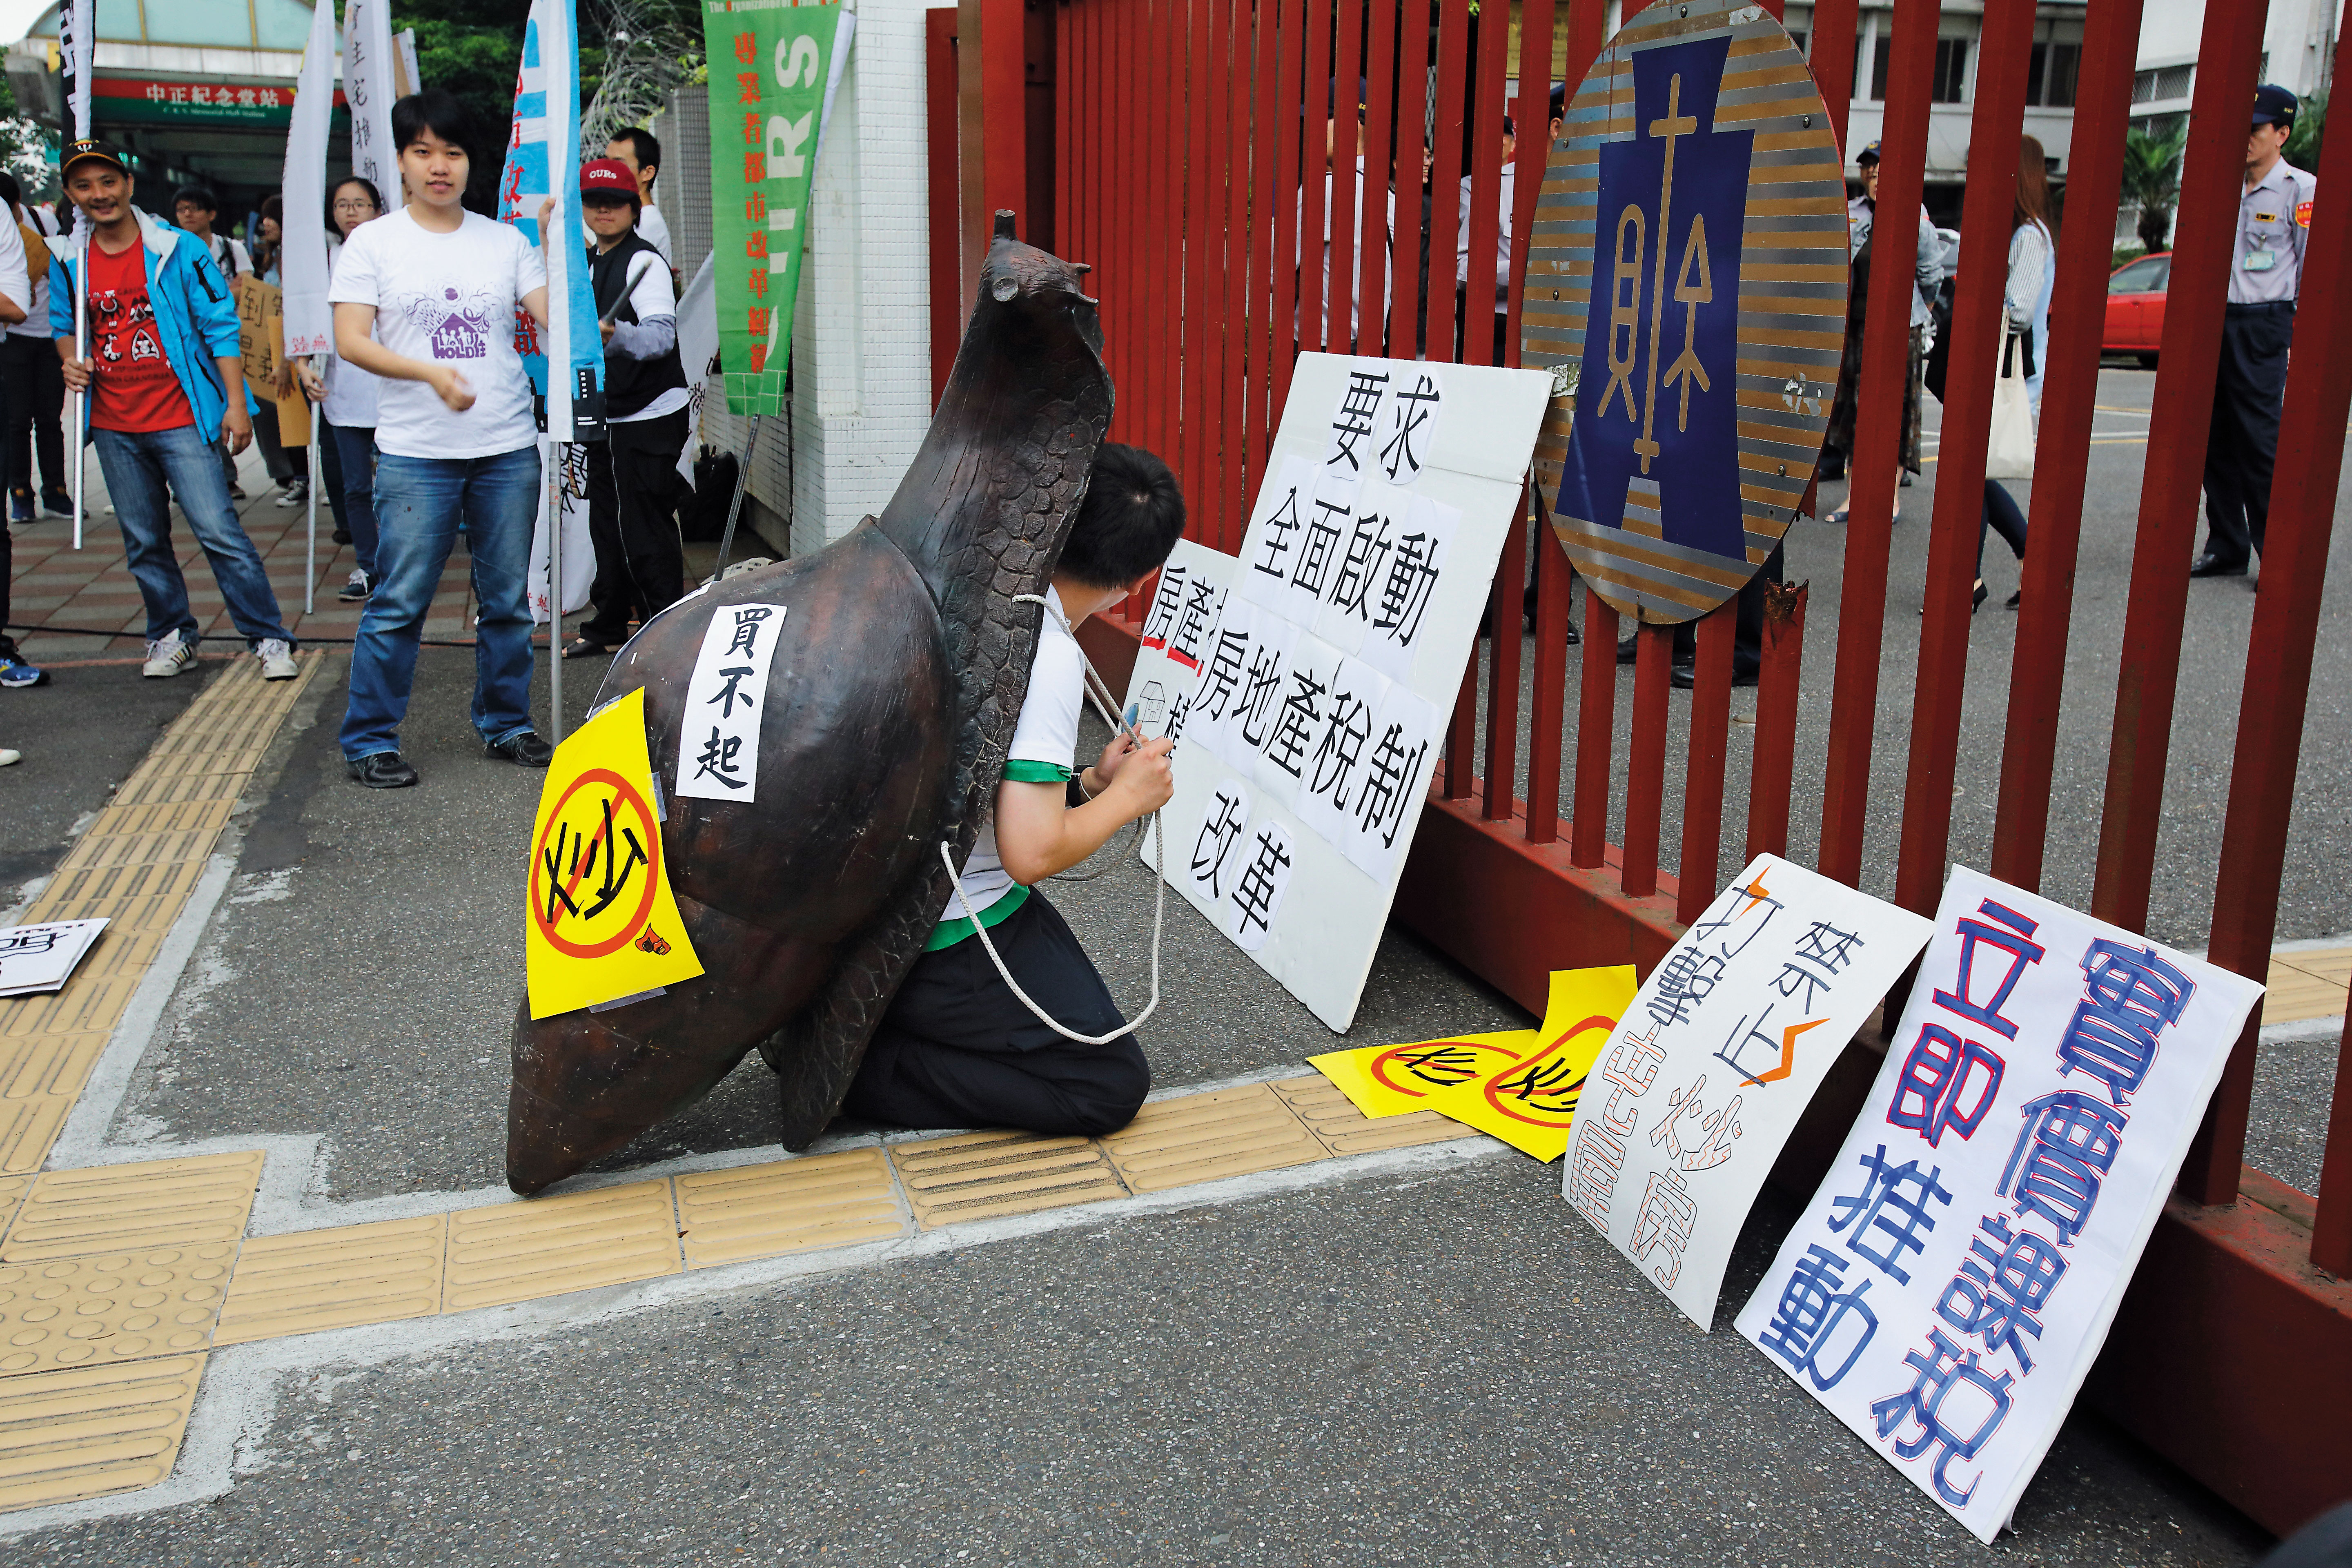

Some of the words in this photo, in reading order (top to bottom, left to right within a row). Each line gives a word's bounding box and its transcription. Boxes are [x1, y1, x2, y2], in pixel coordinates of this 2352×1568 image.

[146, 83, 279, 109] 中正紀念堂站
[1327, 370, 1440, 479] 要求
[1254, 485, 1440, 647] 全面啟動
[694, 607, 773, 789] 買不起
[1192, 627, 1428, 850] 房地產稅制
[544, 798, 648, 924] 炒
[1191, 791, 1292, 934] 改革
[1628, 921, 1865, 1290] 禁止炒房
[1758, 897, 2046, 1392] 立即推動
[1869, 936, 2196, 1510] 實價課稅
